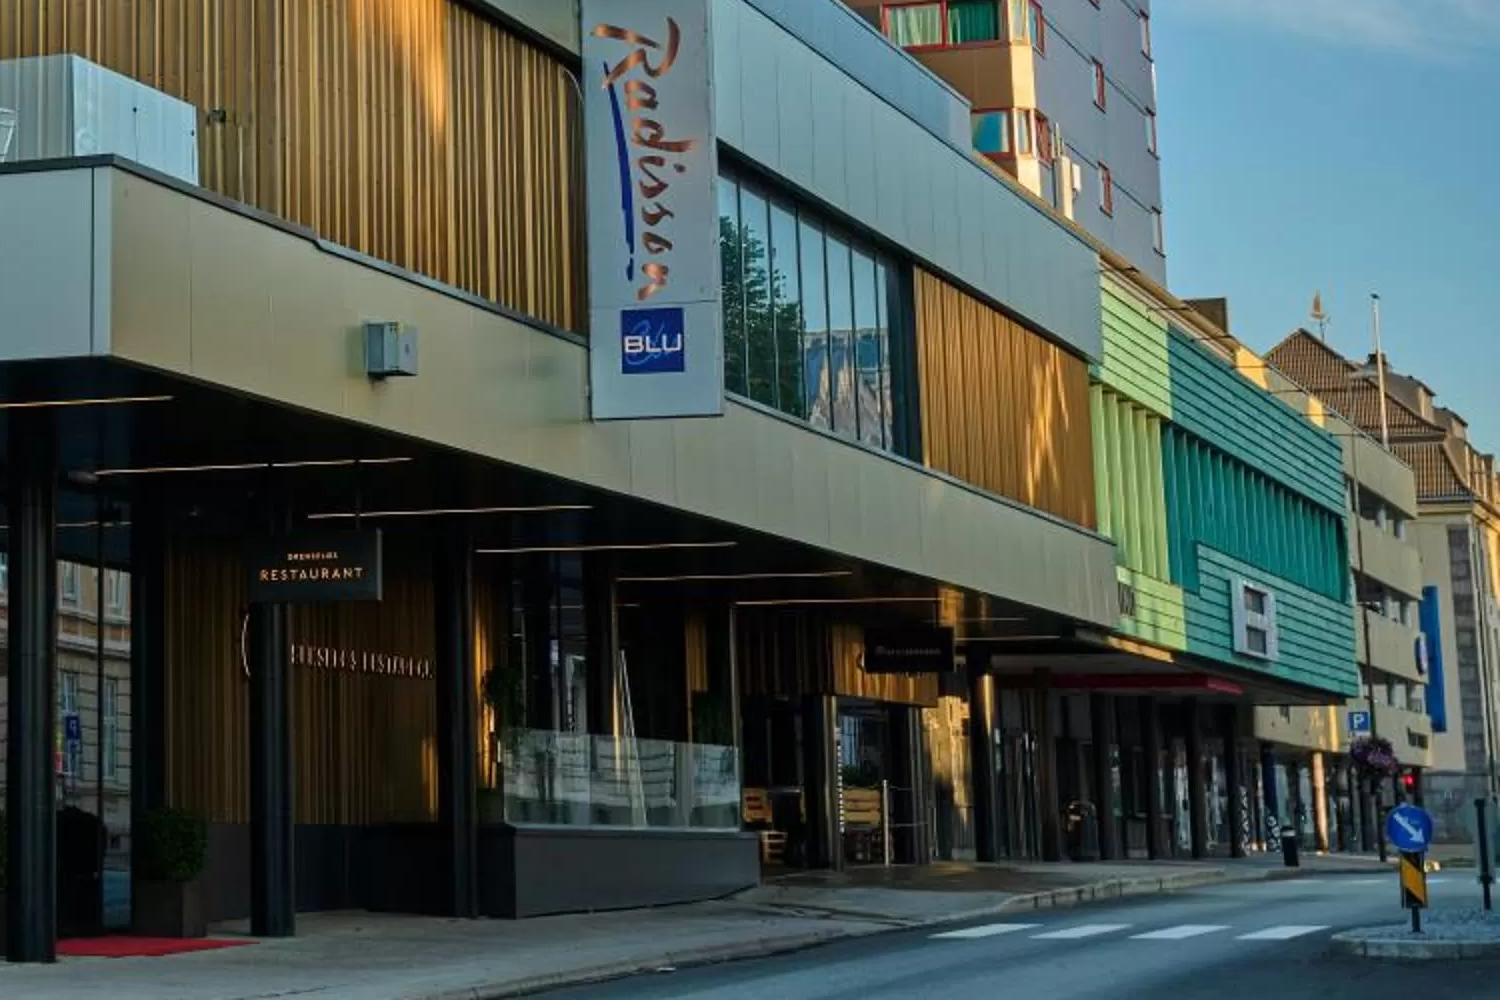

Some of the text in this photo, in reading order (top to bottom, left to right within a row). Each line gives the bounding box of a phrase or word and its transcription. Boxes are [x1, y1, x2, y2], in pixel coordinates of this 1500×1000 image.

[590, 16, 696, 301] Radisson
[623, 333, 683, 355] BLU
[259, 567, 364, 582] RESTAURANT
[1352, 712, 1365, 728] P
